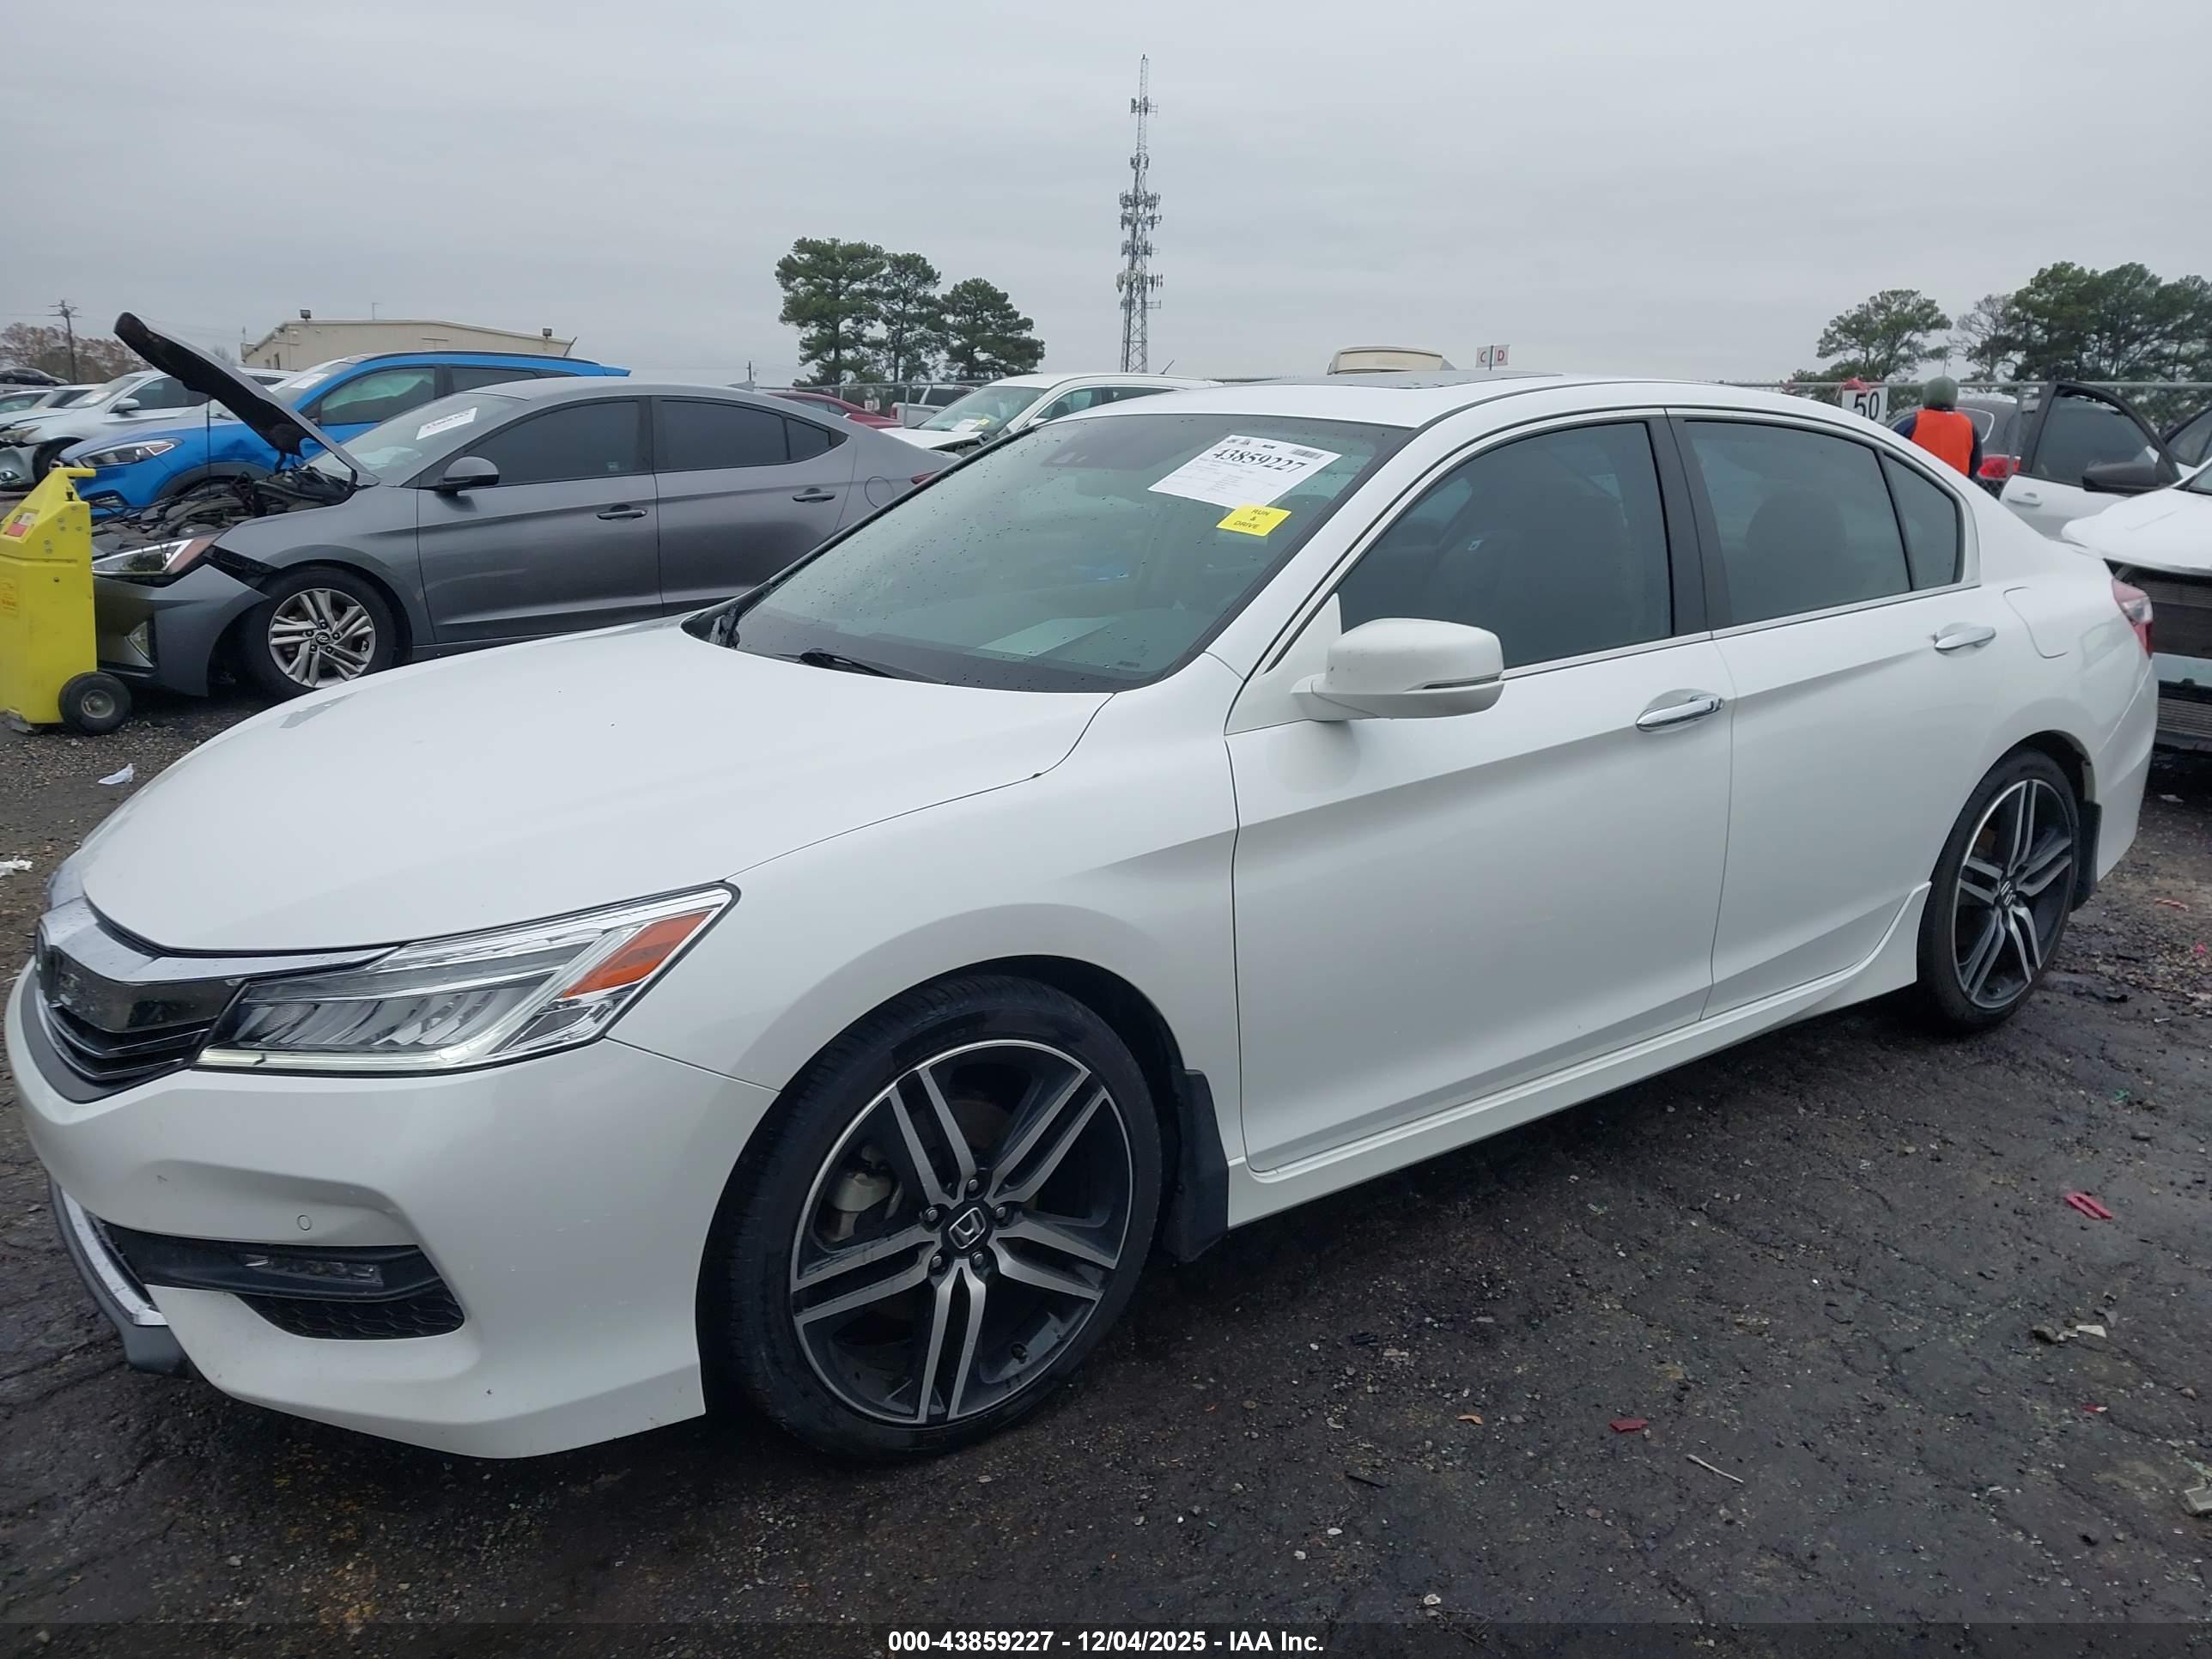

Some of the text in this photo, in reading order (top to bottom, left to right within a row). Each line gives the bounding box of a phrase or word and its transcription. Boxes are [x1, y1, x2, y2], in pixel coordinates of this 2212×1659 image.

[1480, 350, 1486, 362] C
[1497, 349, 1505, 362] D
[1854, 392, 1880, 420] 50
[1212, 448, 1309, 473] 43859227
[1233, 520, 1260, 529] DRIVE
